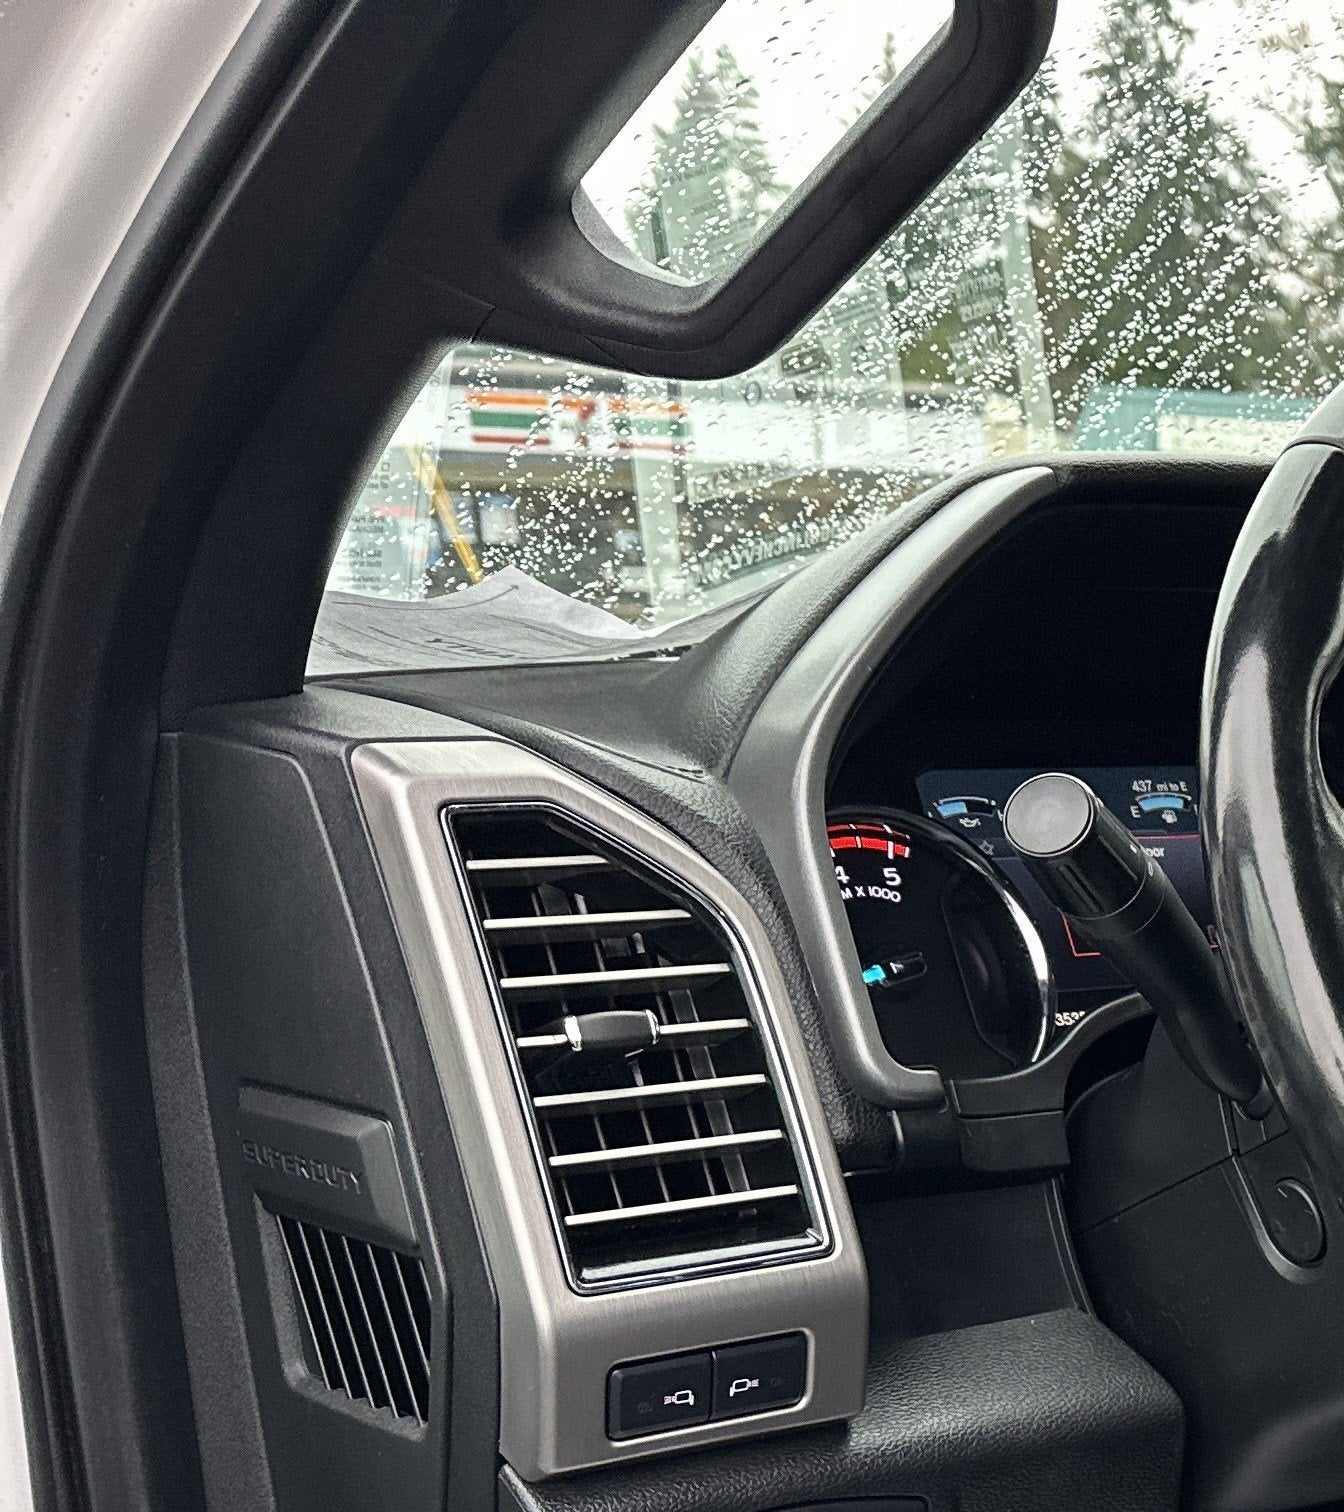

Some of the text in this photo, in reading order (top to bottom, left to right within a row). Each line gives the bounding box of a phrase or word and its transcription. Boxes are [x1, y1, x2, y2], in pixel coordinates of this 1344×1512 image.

[1132, 780, 1152, 792] 437
[883, 868, 901, 886] 5
[868, 886, 901, 902] 1000
